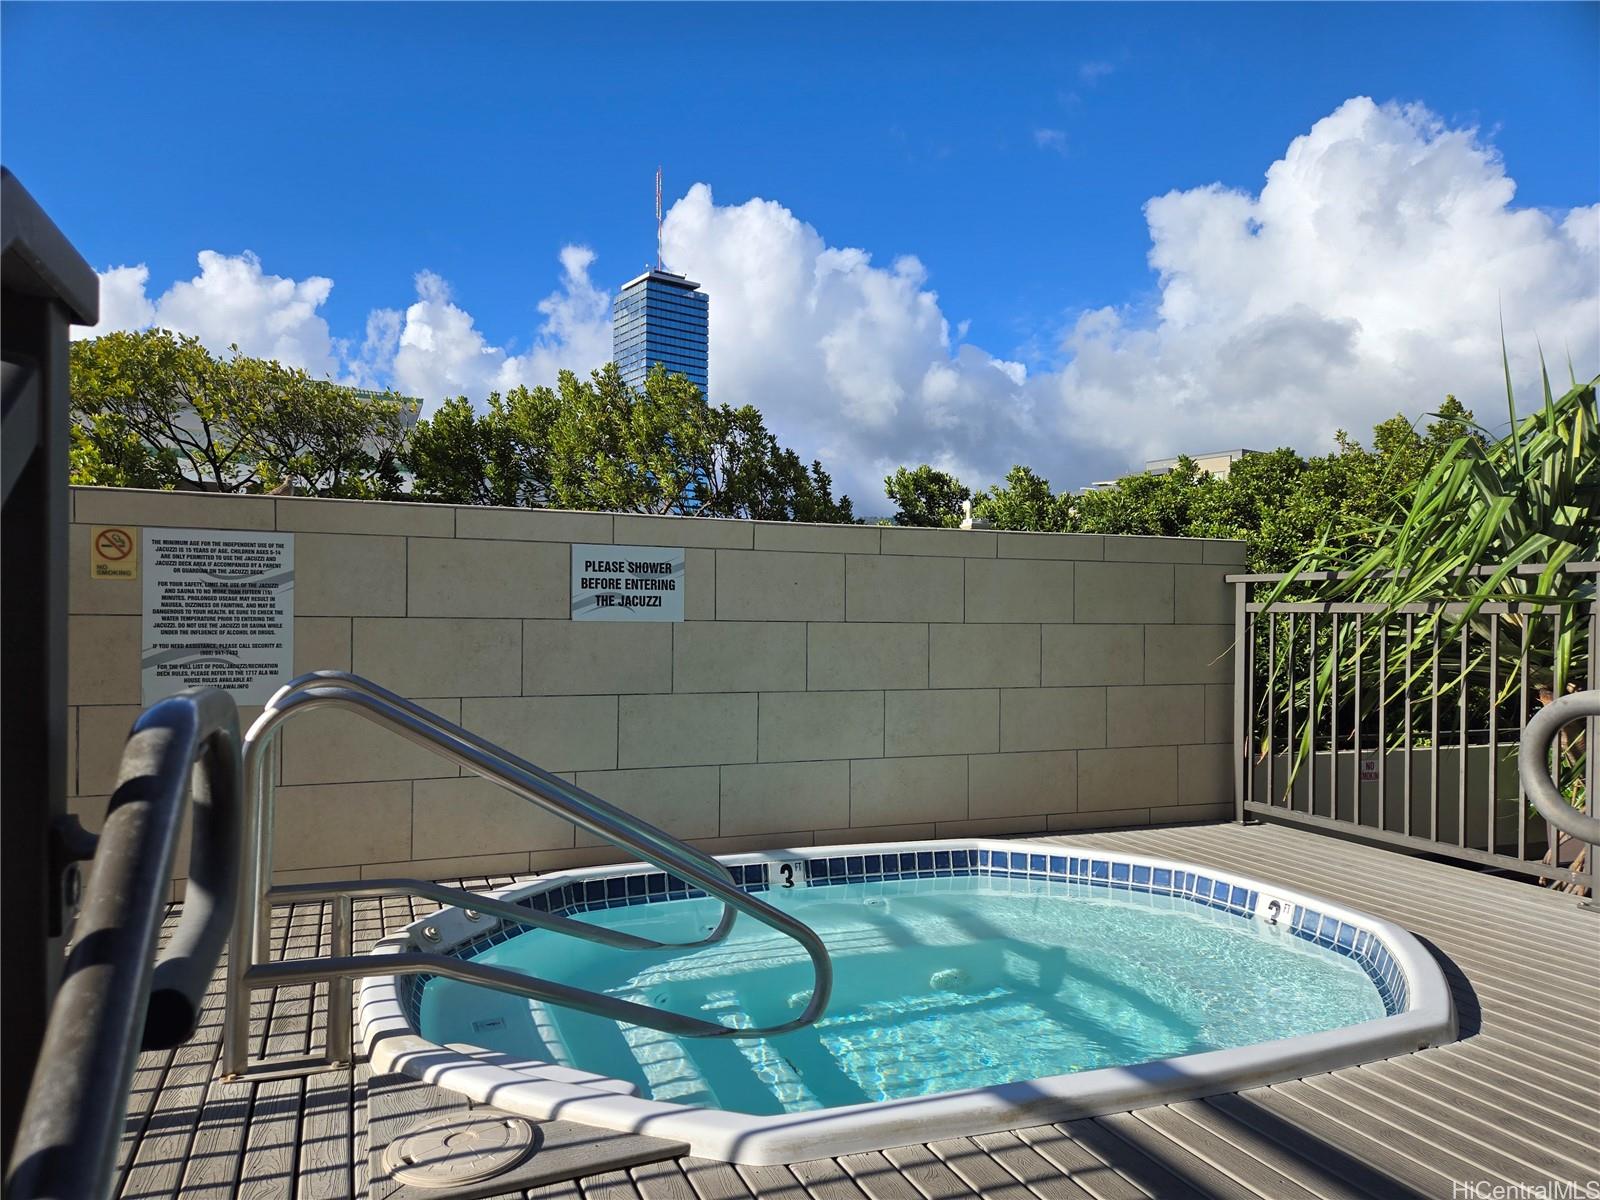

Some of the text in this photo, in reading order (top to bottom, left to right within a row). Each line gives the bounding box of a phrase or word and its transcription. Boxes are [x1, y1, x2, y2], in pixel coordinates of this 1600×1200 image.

[585, 561, 672, 574] PLEASE SHOWER
[581, 578, 676, 590] BEFORE ENTERING
[595, 595, 662, 607] THE JACUZZI
[1366, 761, 1375, 770] NO
[780, 863, 802, 888] 3 FT
